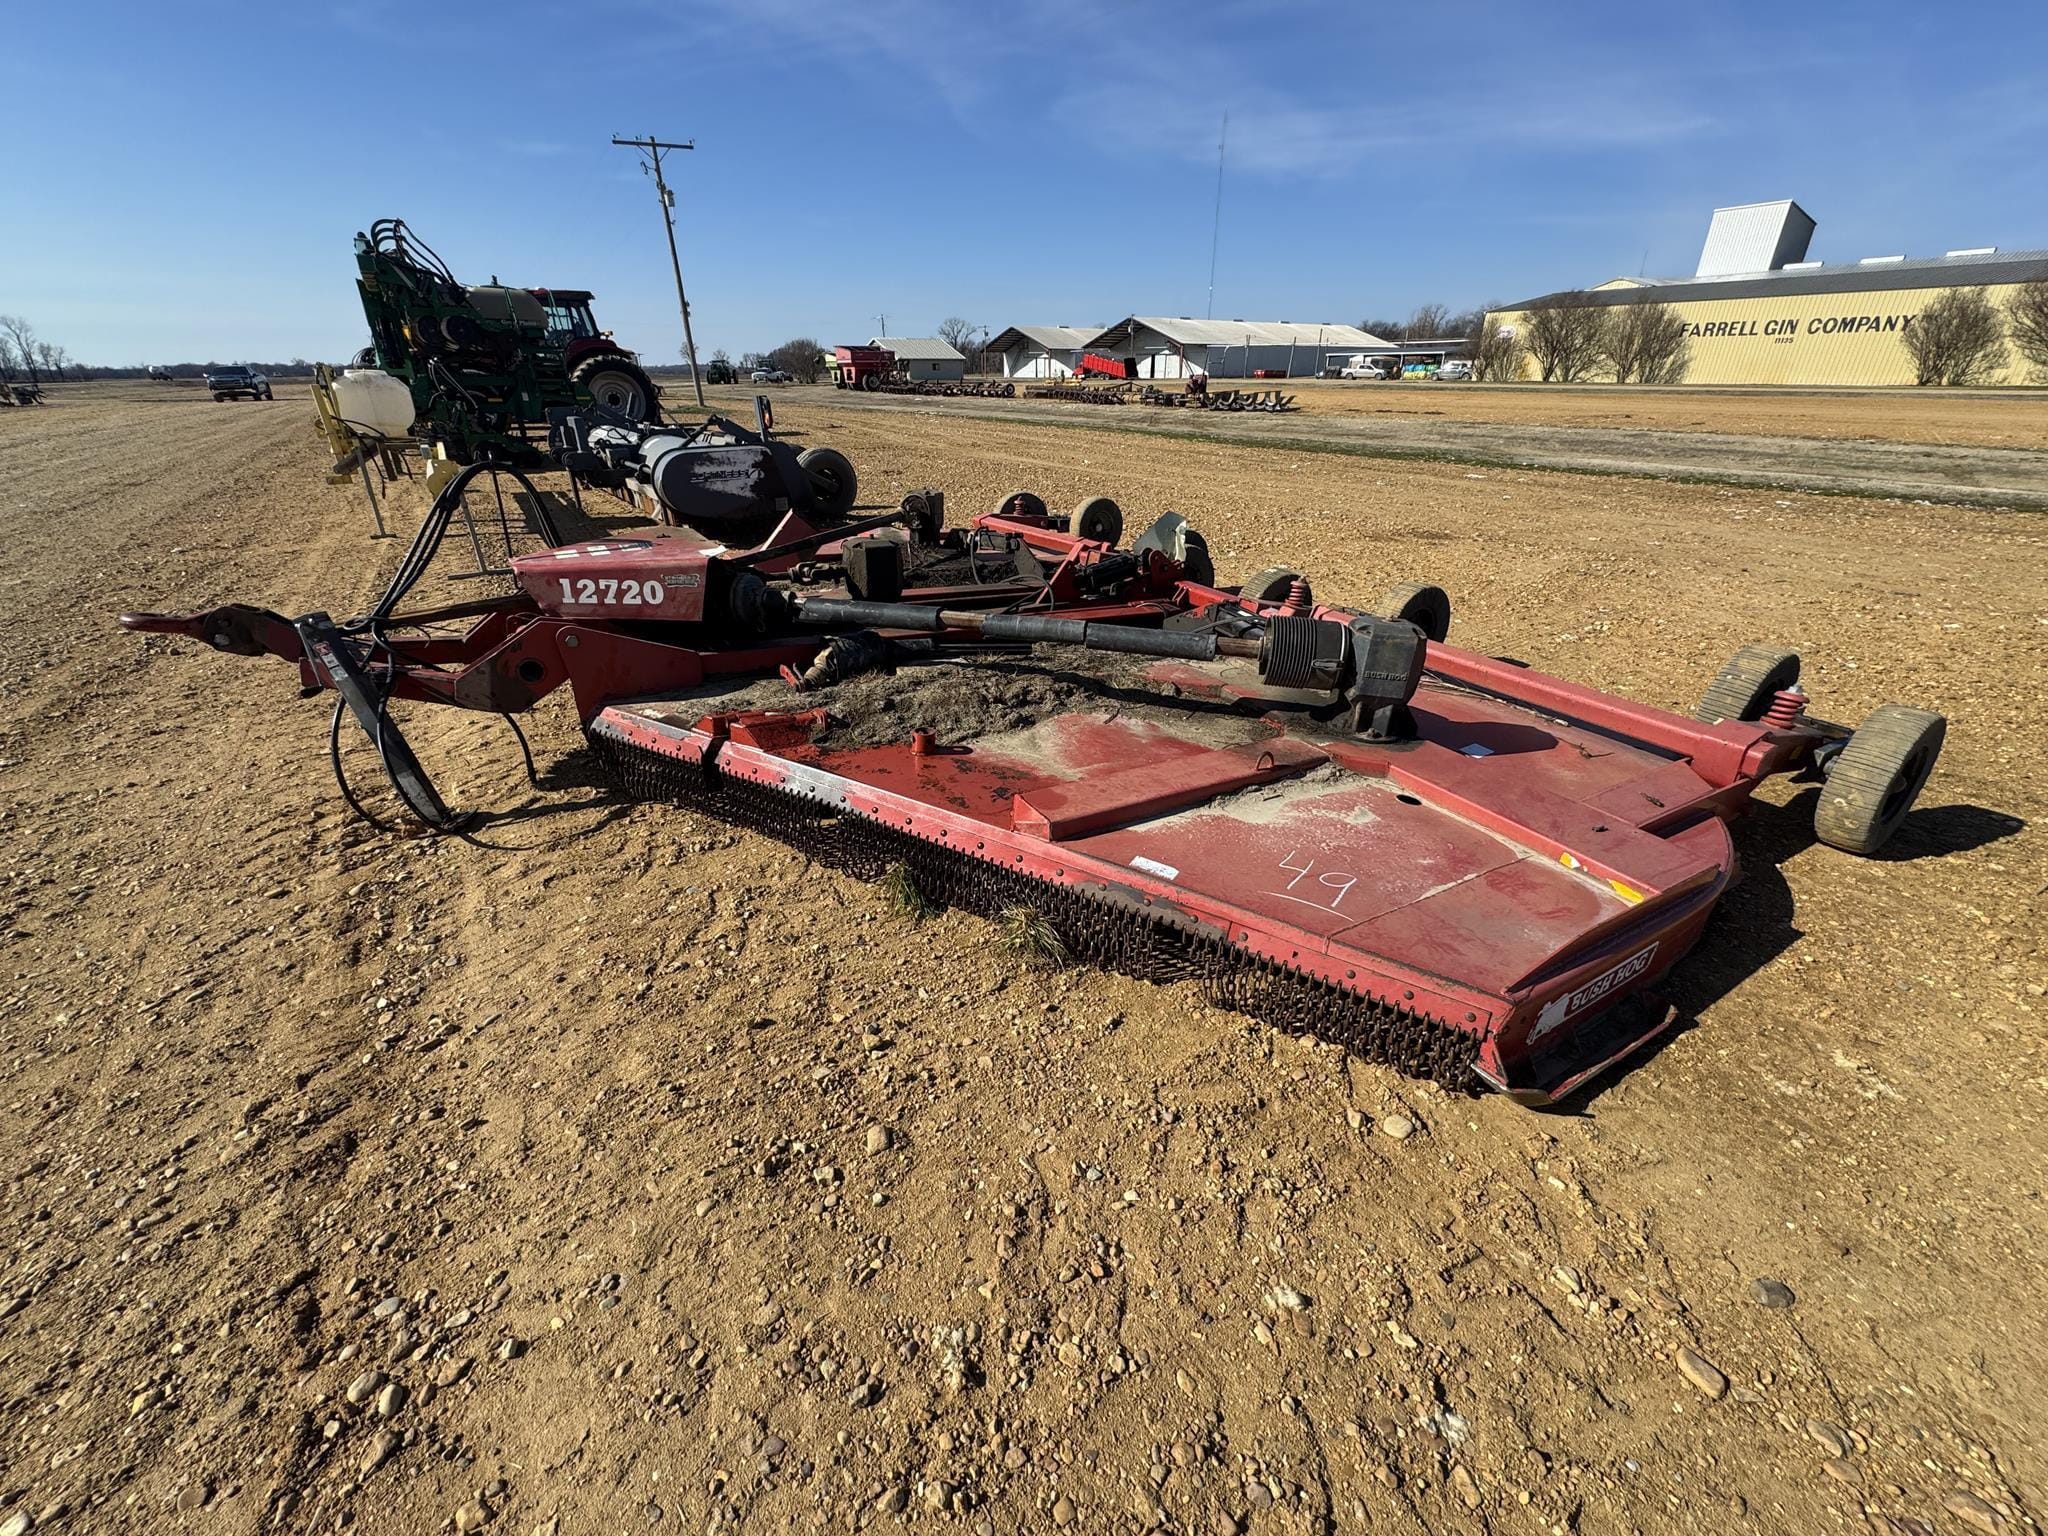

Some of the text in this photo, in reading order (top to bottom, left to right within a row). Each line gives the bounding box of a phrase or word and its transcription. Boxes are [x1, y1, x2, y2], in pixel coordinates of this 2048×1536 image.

[1678, 314, 1918, 338] FARRELL GIN COMPANY
[558, 578, 664, 605] 12720
[1363, 670, 1388, 680] BUSH
[1278, 850, 1357, 908] 49
[1571, 952, 1649, 1010] BUSH HOG
